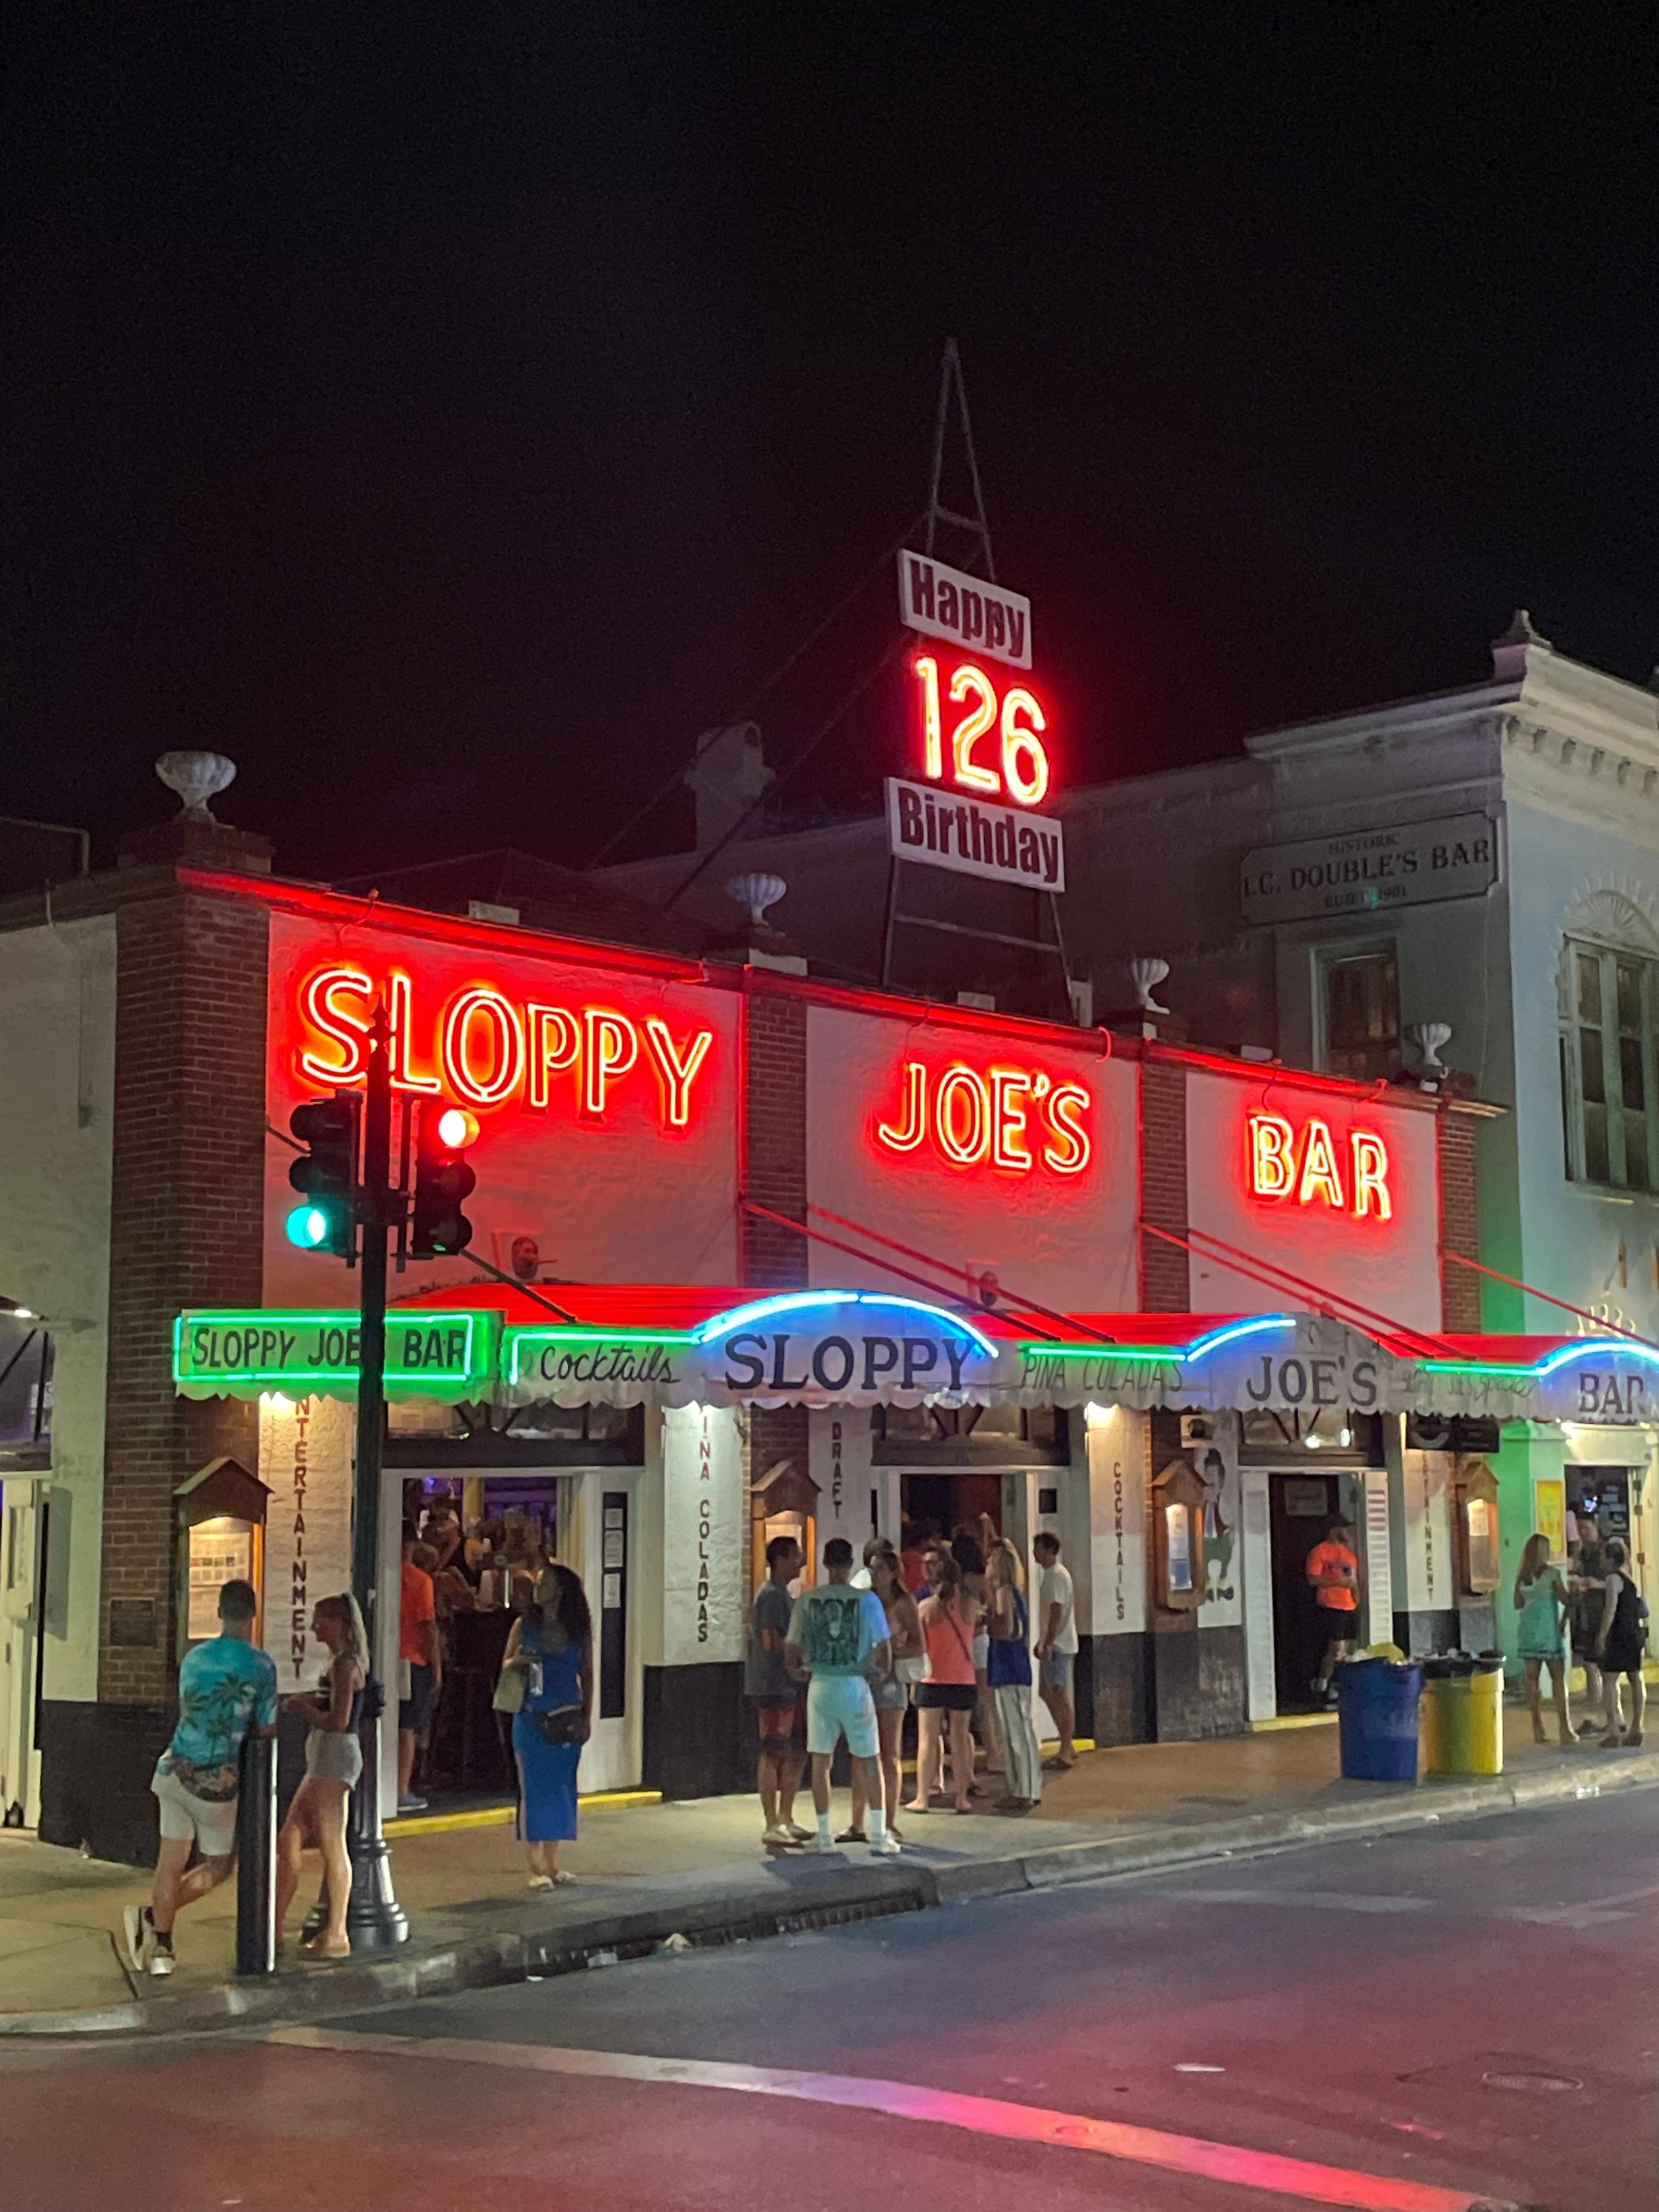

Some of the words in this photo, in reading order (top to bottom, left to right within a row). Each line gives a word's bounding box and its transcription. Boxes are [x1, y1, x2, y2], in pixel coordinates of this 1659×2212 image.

[909, 558, 1025, 658] Happy
[915, 656, 1049, 805] 126
[898, 787, 1059, 883] Birthday
[1291, 850, 1419, 891] DOUBLE'S
[1432, 839, 1491, 870] BAR
[295, 968, 712, 1132] SLOPPY
[873, 1062, 1091, 1177] JOE'S
[1246, 1110, 1392, 1221] BAR
[192, 1327, 296, 1370] SLOPPY
[403, 1328, 466, 1368] BAR
[540, 1342, 681, 1384] Cocktails
[724, 1334, 977, 1392] SLOPPY
[1082, 1357, 1184, 1392] COLADAS
[1246, 1356, 1378, 1407] JOE'S
[1579, 1373, 1646, 1414] BAR
[832, 1422, 843, 1519] DRAFT
[292, 1396, 309, 1679] NTERTAINMENT
[697, 1499, 710, 1643] COLADAS
[1113, 1462, 1125, 1621] COCKTAILS
